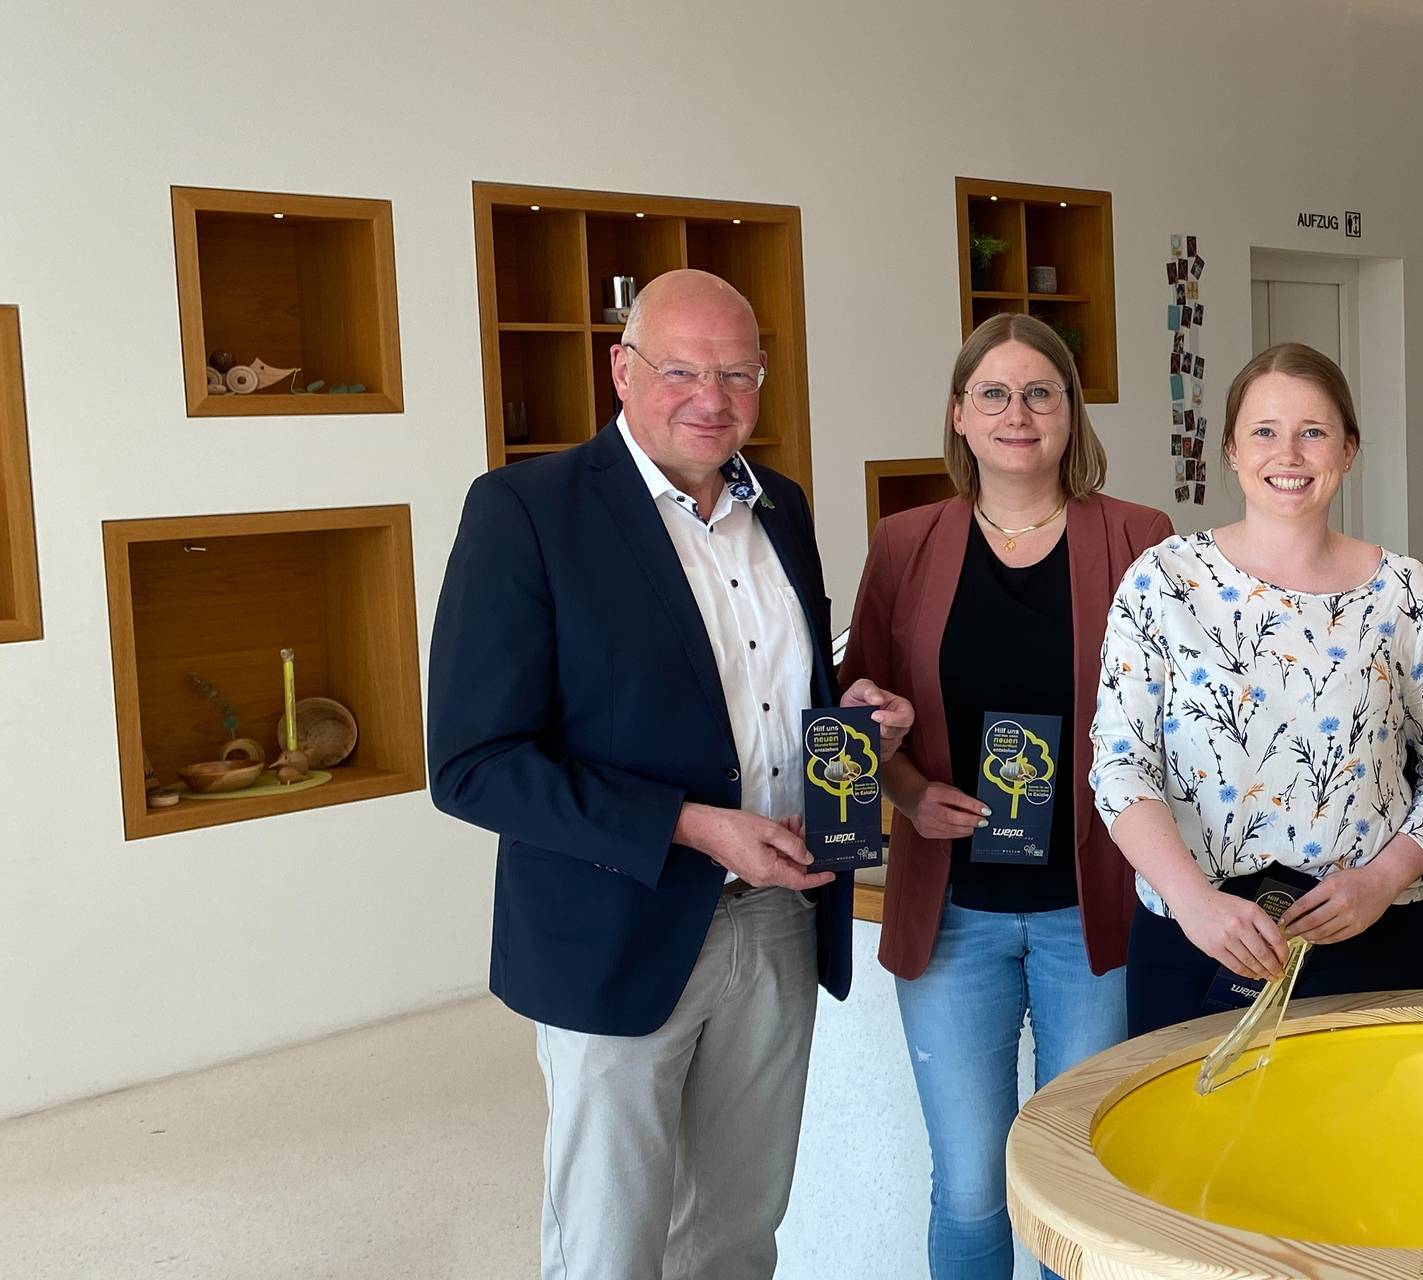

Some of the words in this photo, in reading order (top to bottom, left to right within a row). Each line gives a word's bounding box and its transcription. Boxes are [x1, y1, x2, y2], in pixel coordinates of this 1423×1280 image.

[1297, 212, 1339, 230] AUFZUG
[813, 735, 839, 743] neuen
[824, 832, 856, 844] wepa
[992, 828, 1024, 838] wepa
